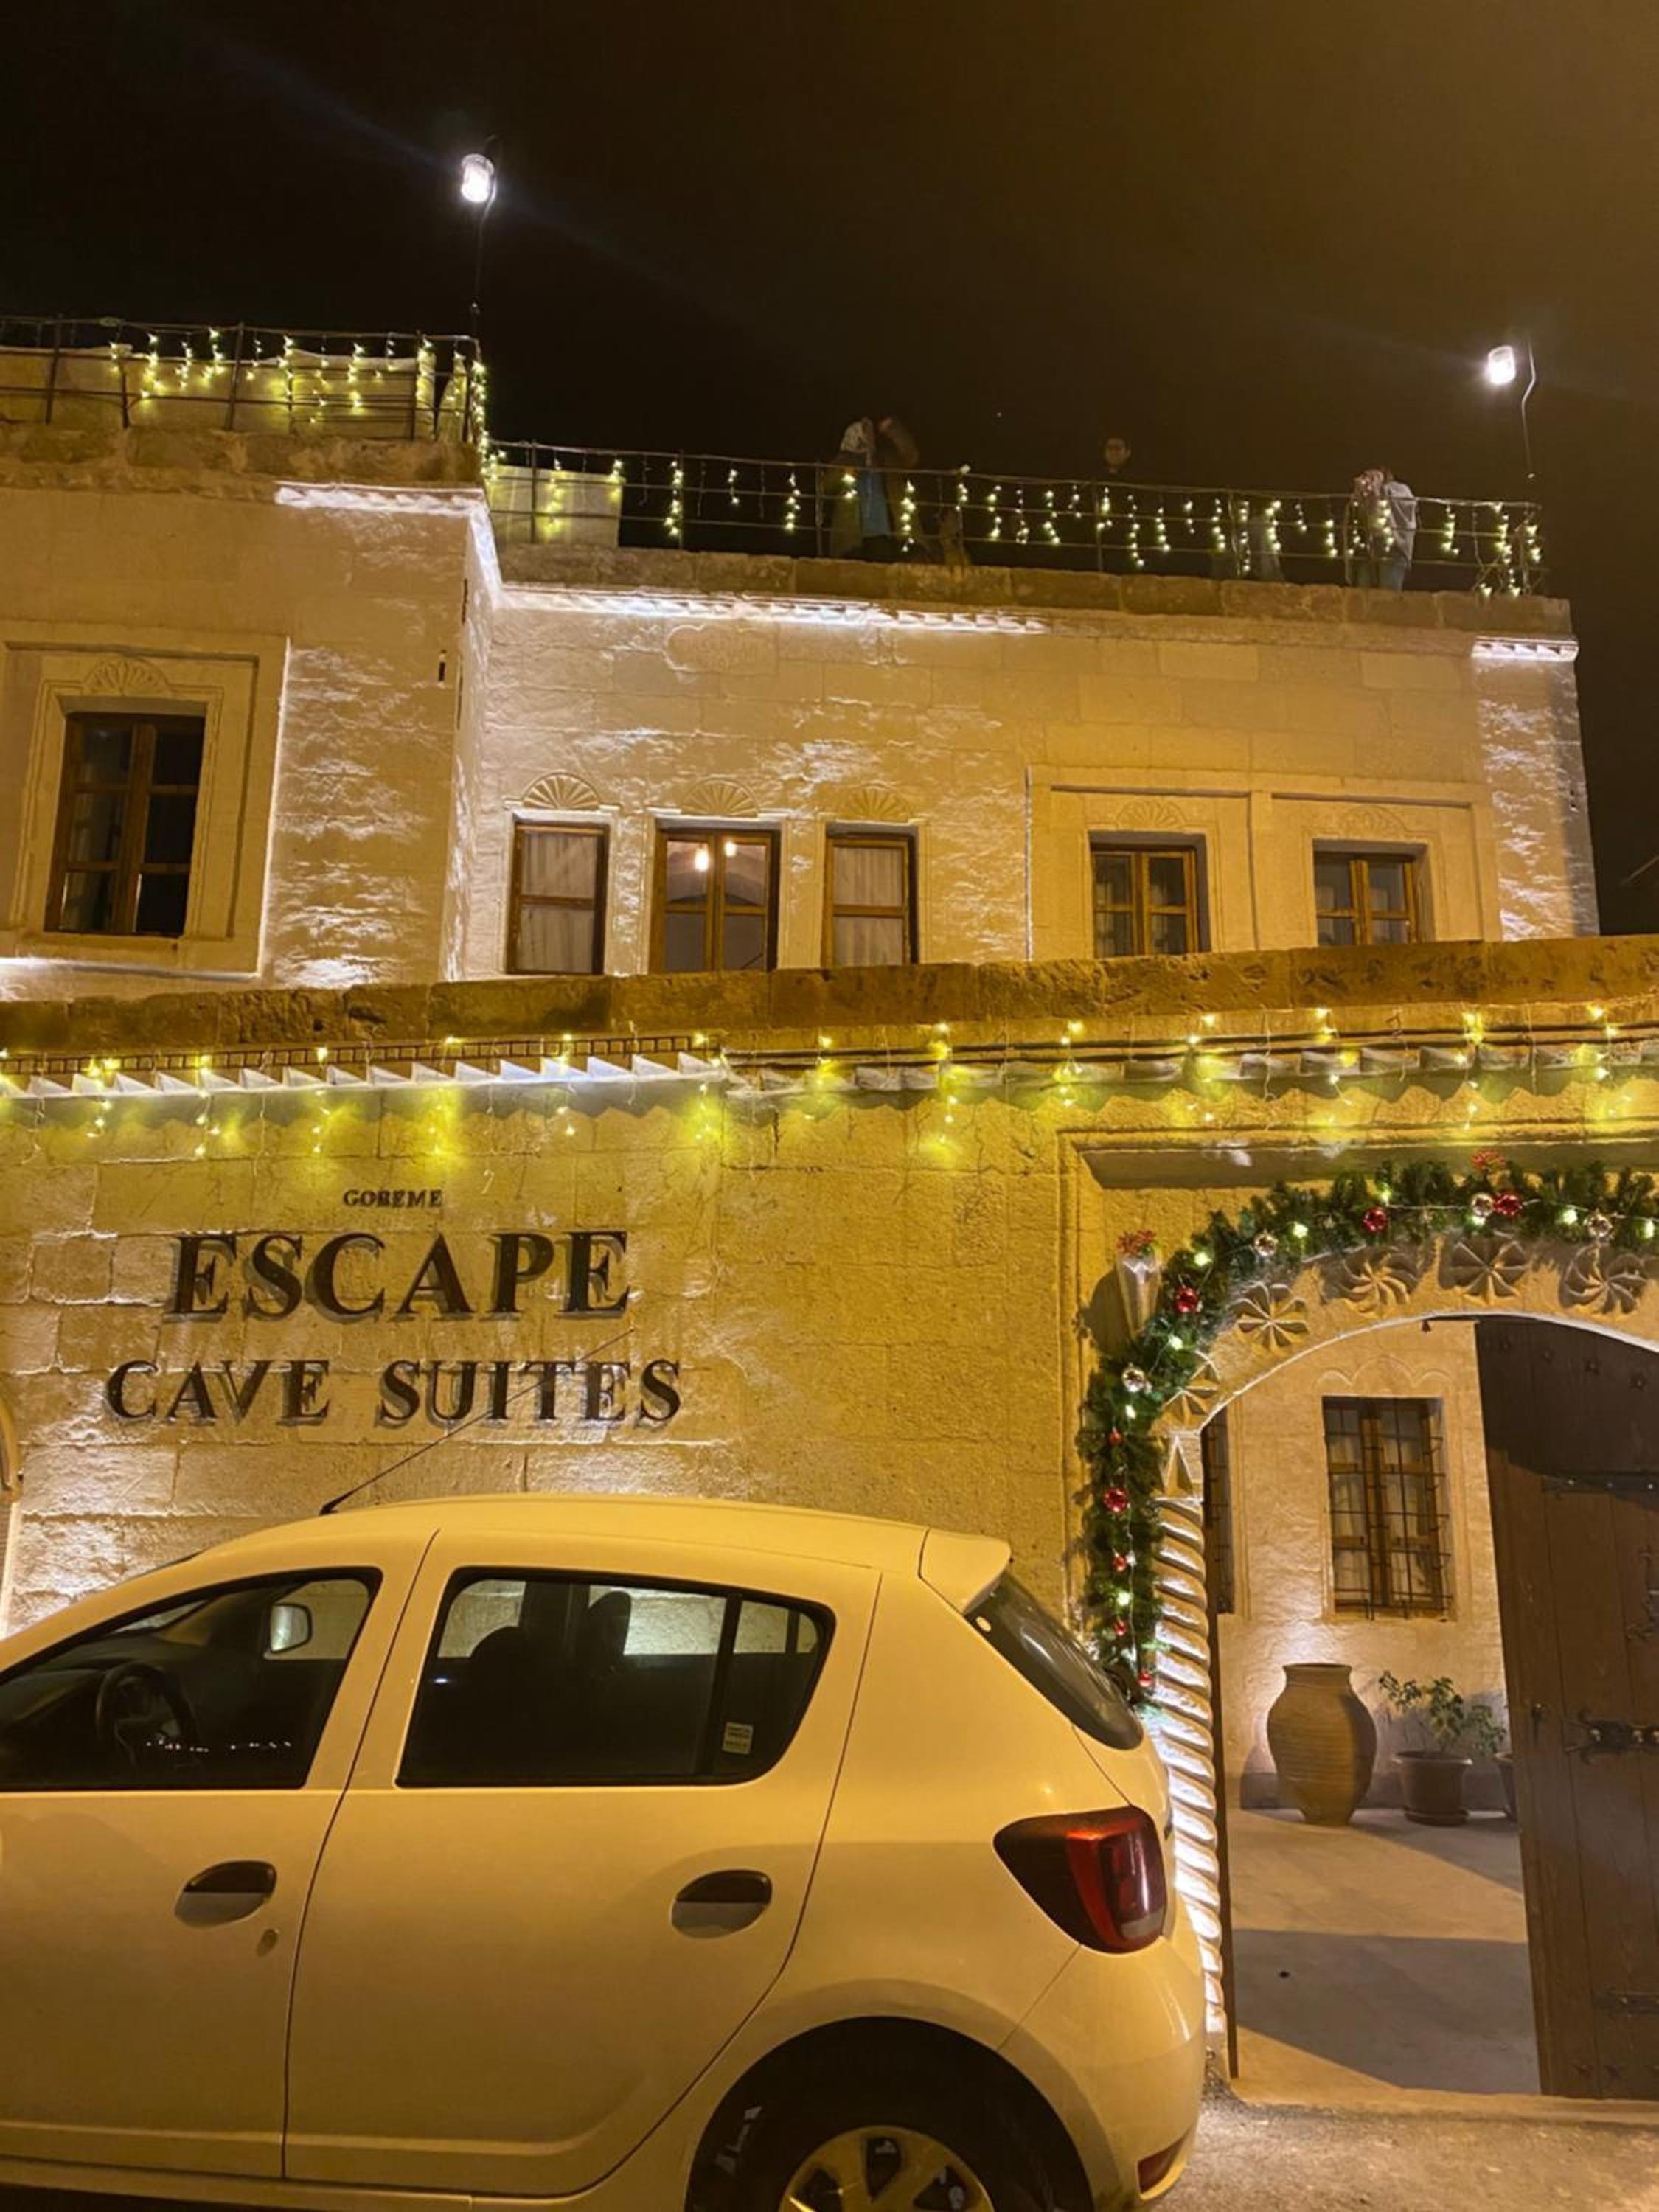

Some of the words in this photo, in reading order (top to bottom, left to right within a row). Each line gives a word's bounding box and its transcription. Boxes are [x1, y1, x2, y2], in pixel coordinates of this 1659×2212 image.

[171, 1231, 630, 1319] ESCAPE
[106, 1360, 332, 1422] CAVE
[379, 1359, 681, 1422] SUITES
